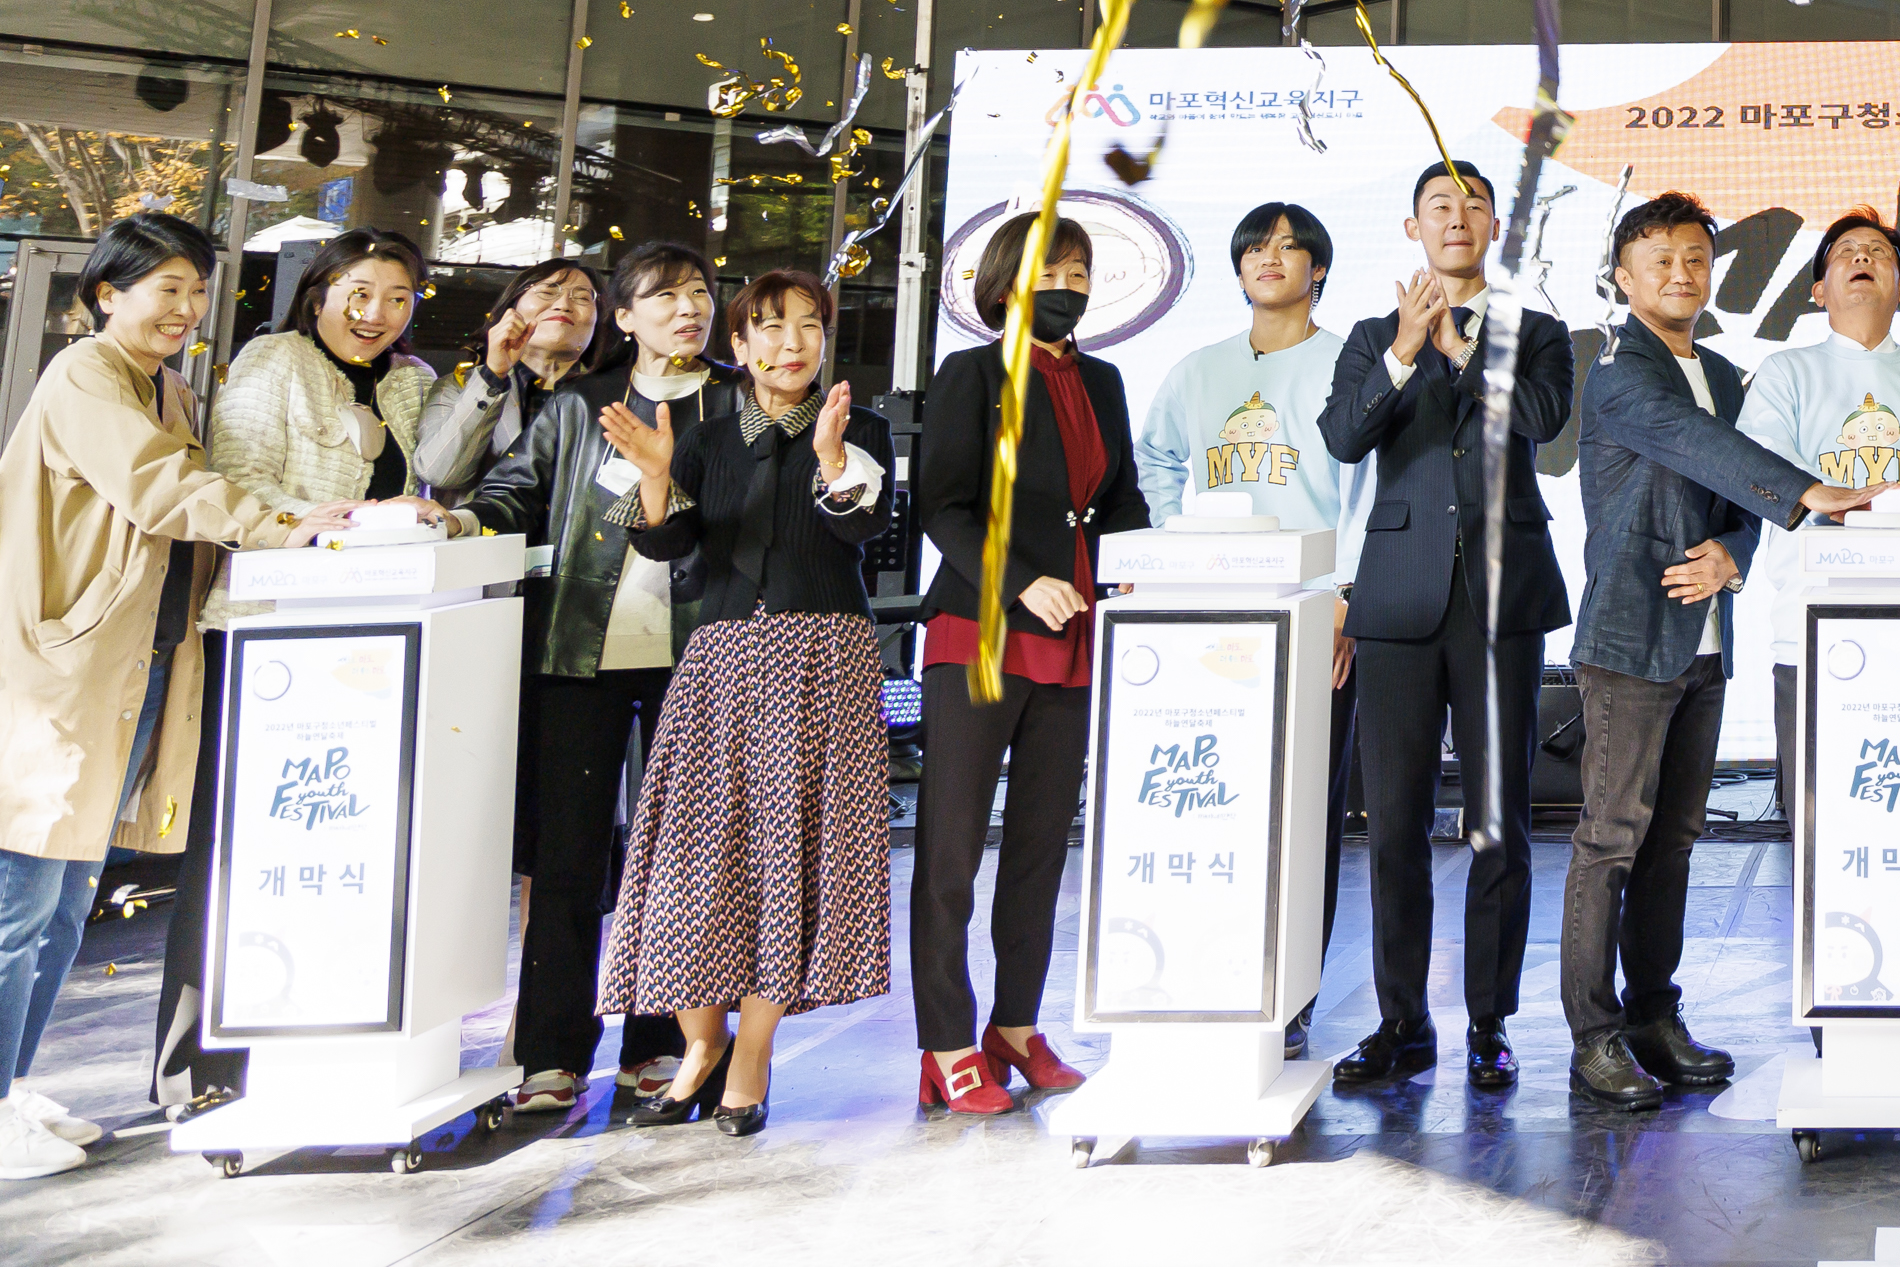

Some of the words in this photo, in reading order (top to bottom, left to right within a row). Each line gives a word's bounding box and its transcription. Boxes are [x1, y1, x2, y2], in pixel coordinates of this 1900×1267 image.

[1149, 90, 1364, 111] 마포혁신교육지구
[1625, 105, 1725, 129] 2022
[1206, 441, 1300, 489] MYF
[1133, 708, 1162, 717] 2022년
[1841, 703, 1870, 712] 2022년
[1149, 734, 1220, 774] MAPO
[281, 746, 351, 787] MAPO
[1138, 766, 1240, 818] FESTIVAL
[1163, 769, 1218, 792] youth
[295, 781, 349, 805] youth
[269, 780, 370, 831] FESTIVAL
